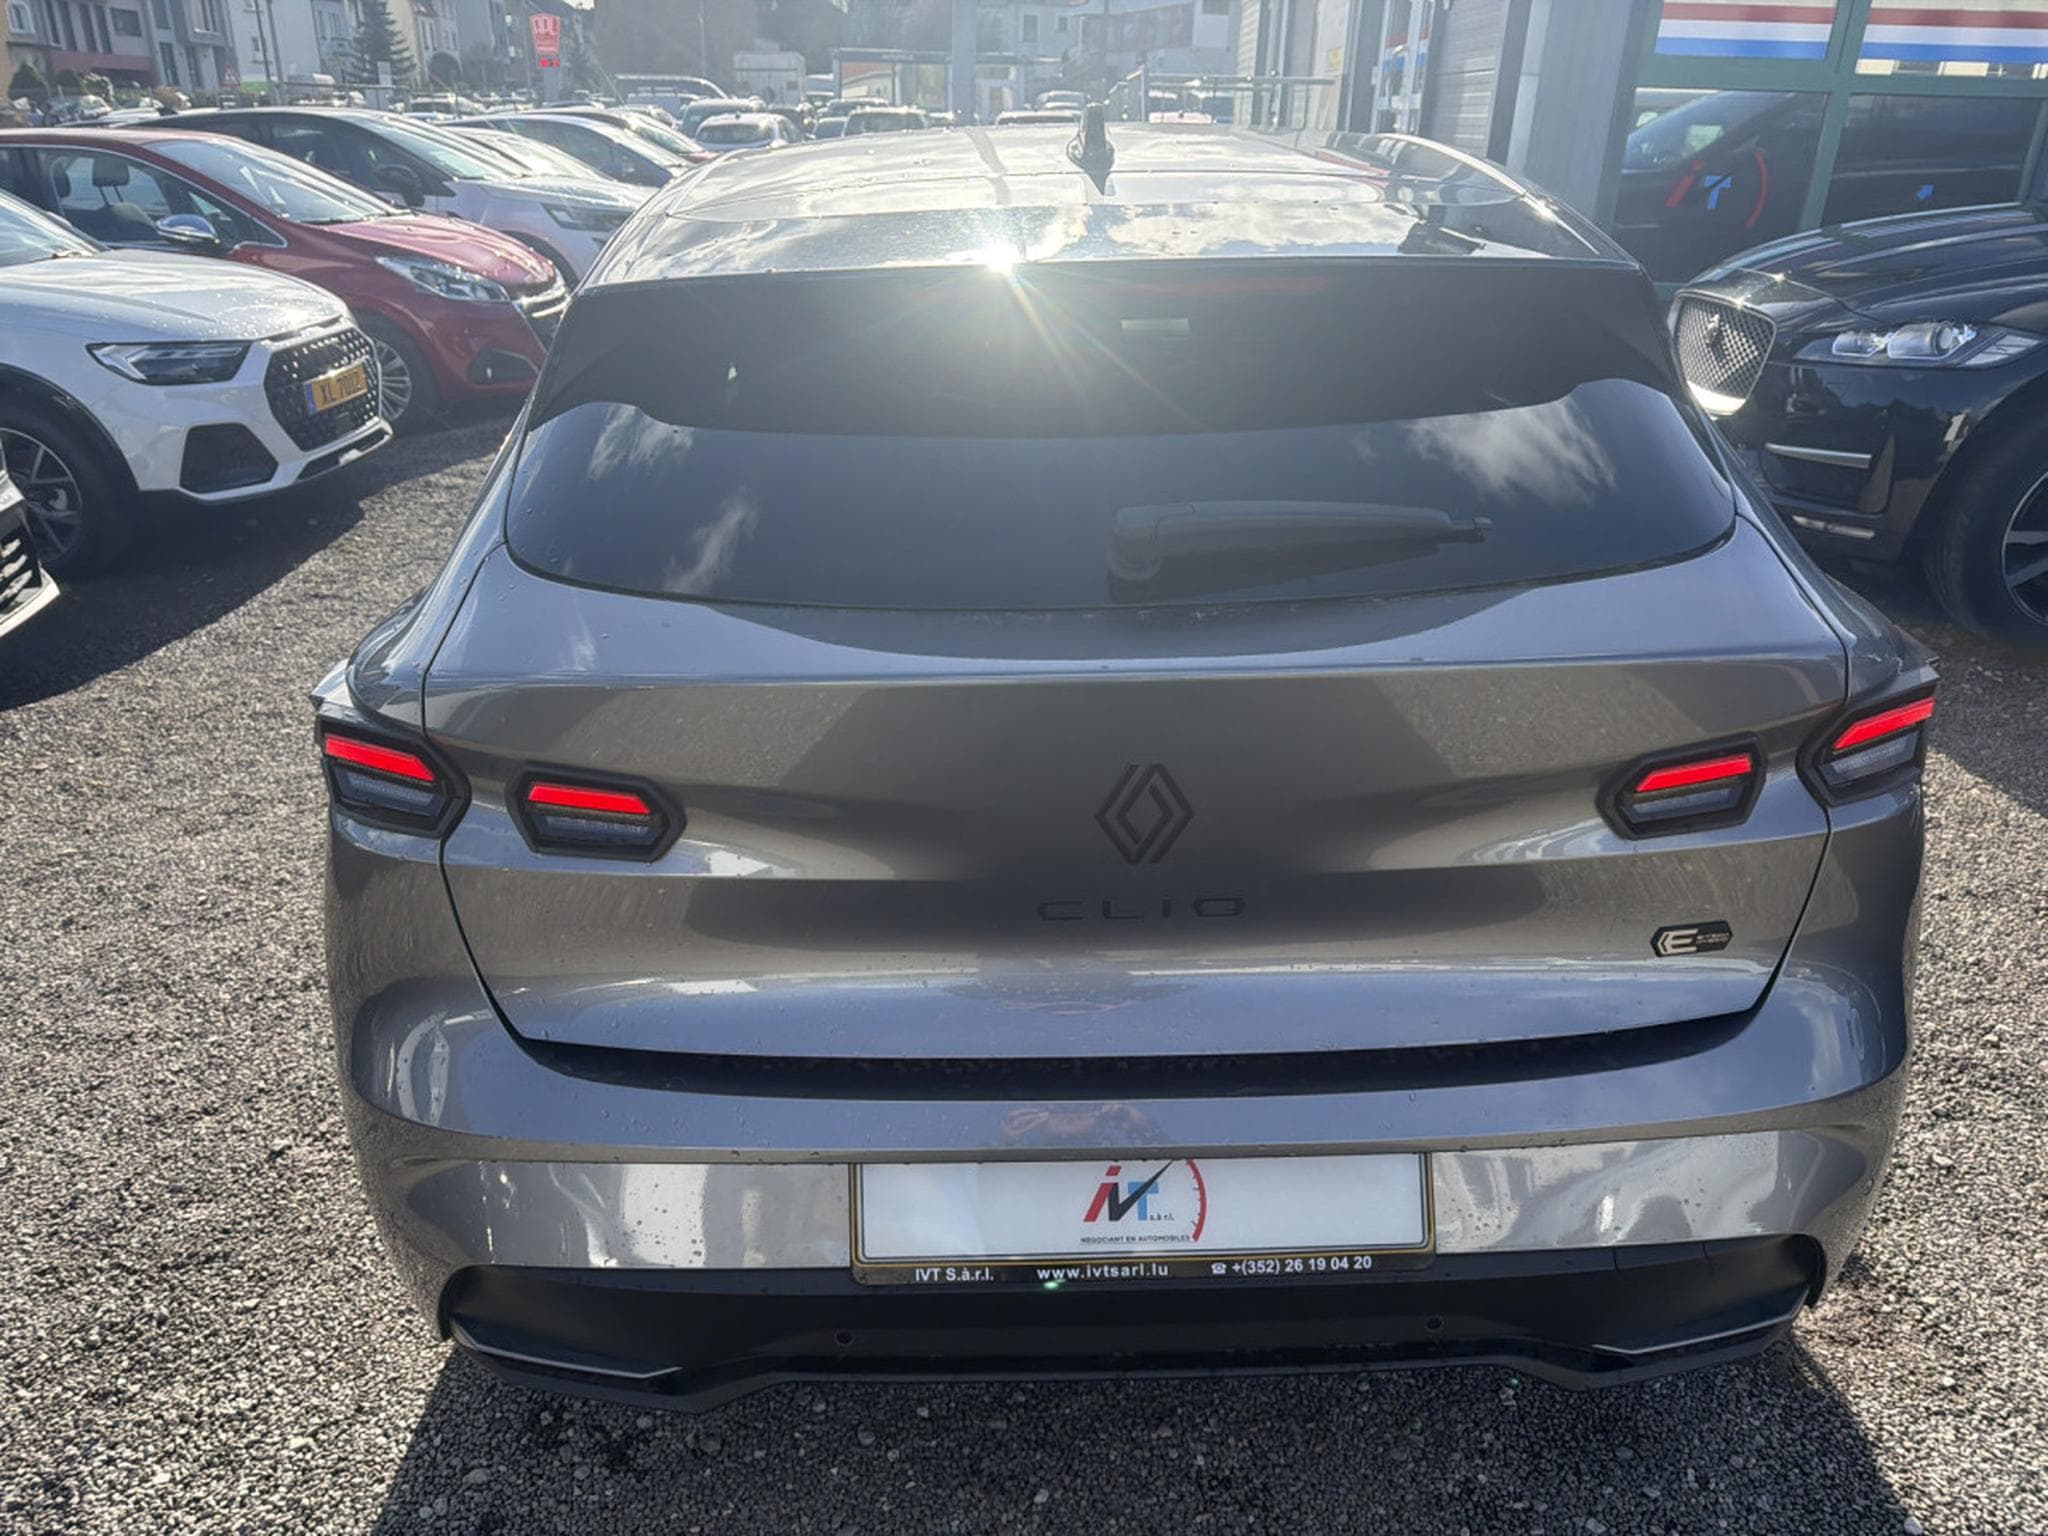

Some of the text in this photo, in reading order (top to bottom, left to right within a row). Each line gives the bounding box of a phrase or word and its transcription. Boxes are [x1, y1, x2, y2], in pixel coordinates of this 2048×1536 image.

[1037, 897, 1246, 921] CLIO
[915, 1268, 941, 1282] IVT
[1036, 1263, 1169, 1280] www.ivtsarl.lu
[1232, 1255, 1373, 1276] +(352) 26 19 04 20
